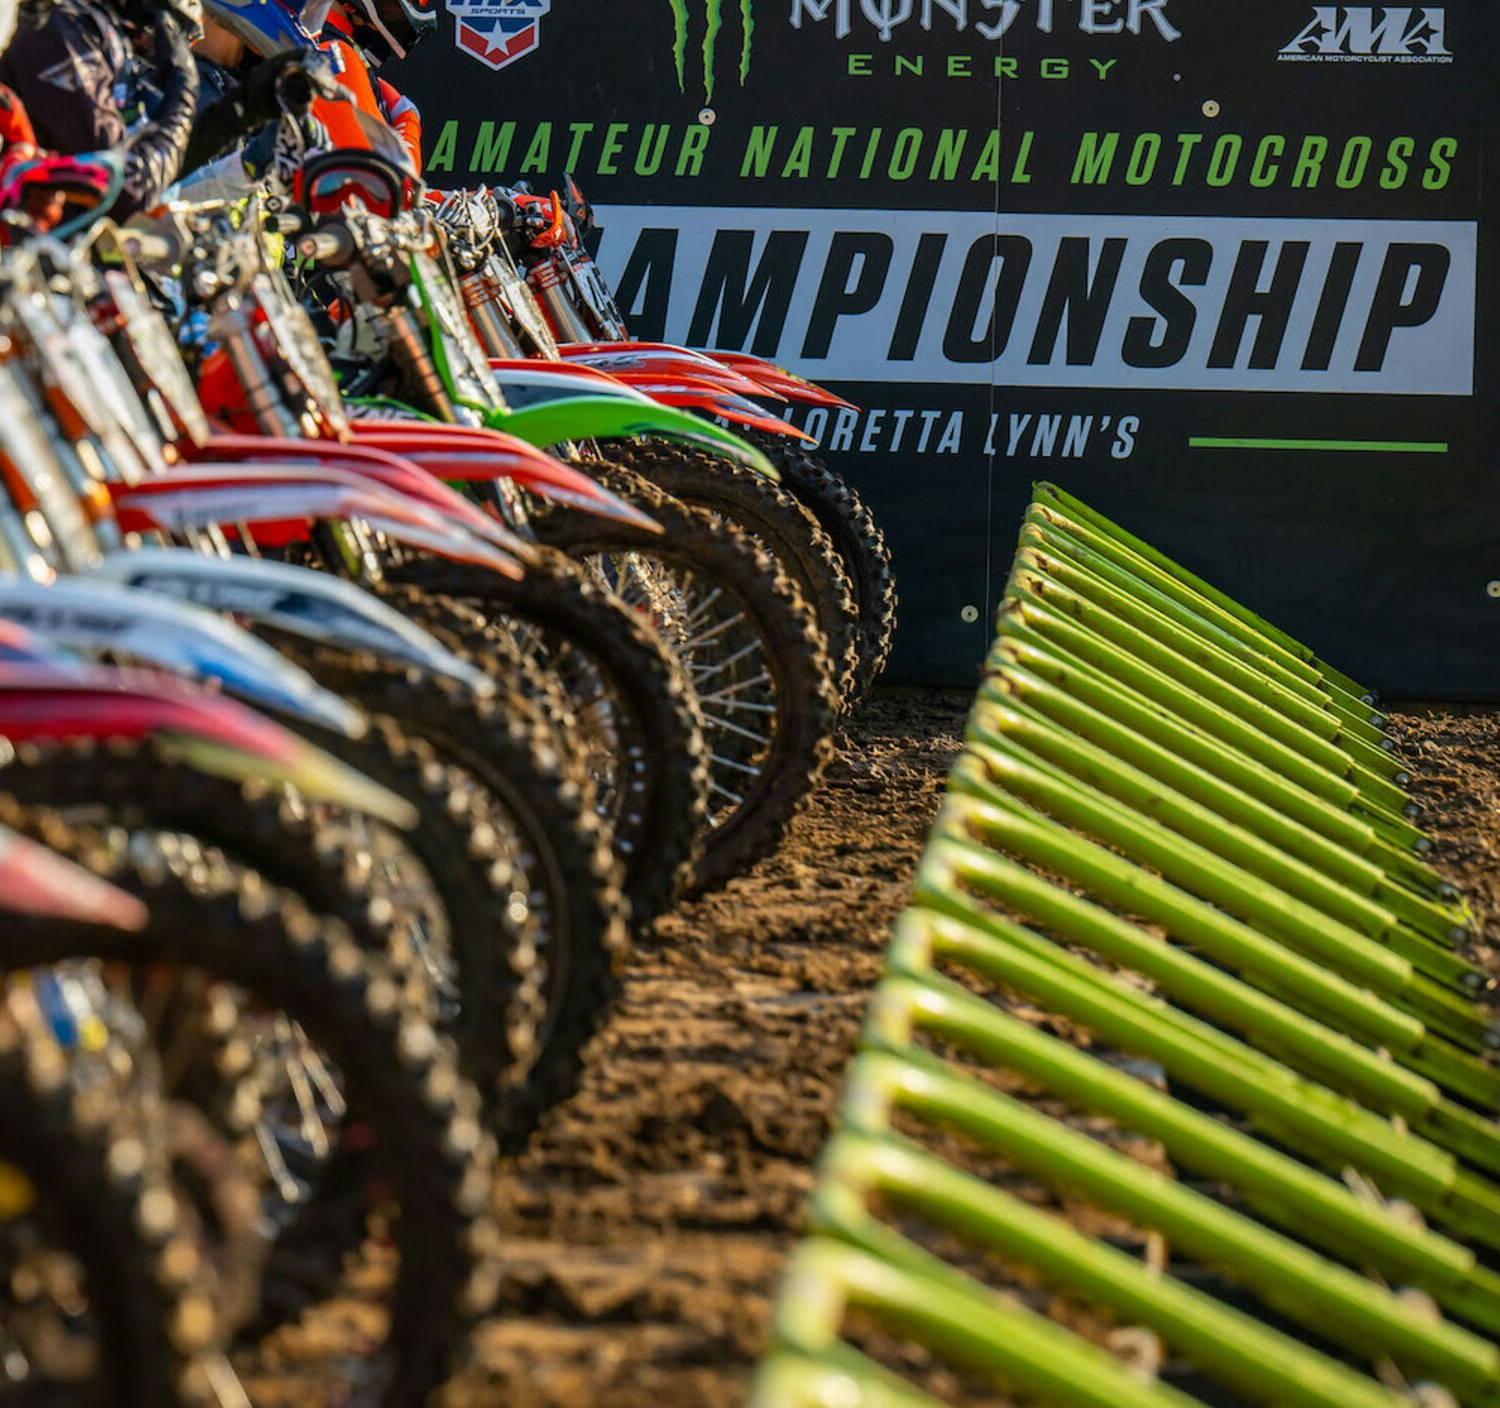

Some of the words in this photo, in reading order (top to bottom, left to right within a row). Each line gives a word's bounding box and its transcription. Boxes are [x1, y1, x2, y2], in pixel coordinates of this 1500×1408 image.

[788, 0, 1182, 42] MONSTER
[1278, 6, 1453, 54] AMA
[848, 54, 1117, 80] ENERGY
[1325, 55, 1392, 63] MOTORCYCLIST
[1394, 56, 1453, 64] ASSOCIATION
[426, 120, 710, 177] AMATEUR
[739, 125, 1035, 184] NATIONAL
[1070, 131, 1459, 190] MOTOCROSS
[585, 226, 1451, 373] AMPIONSHIP
